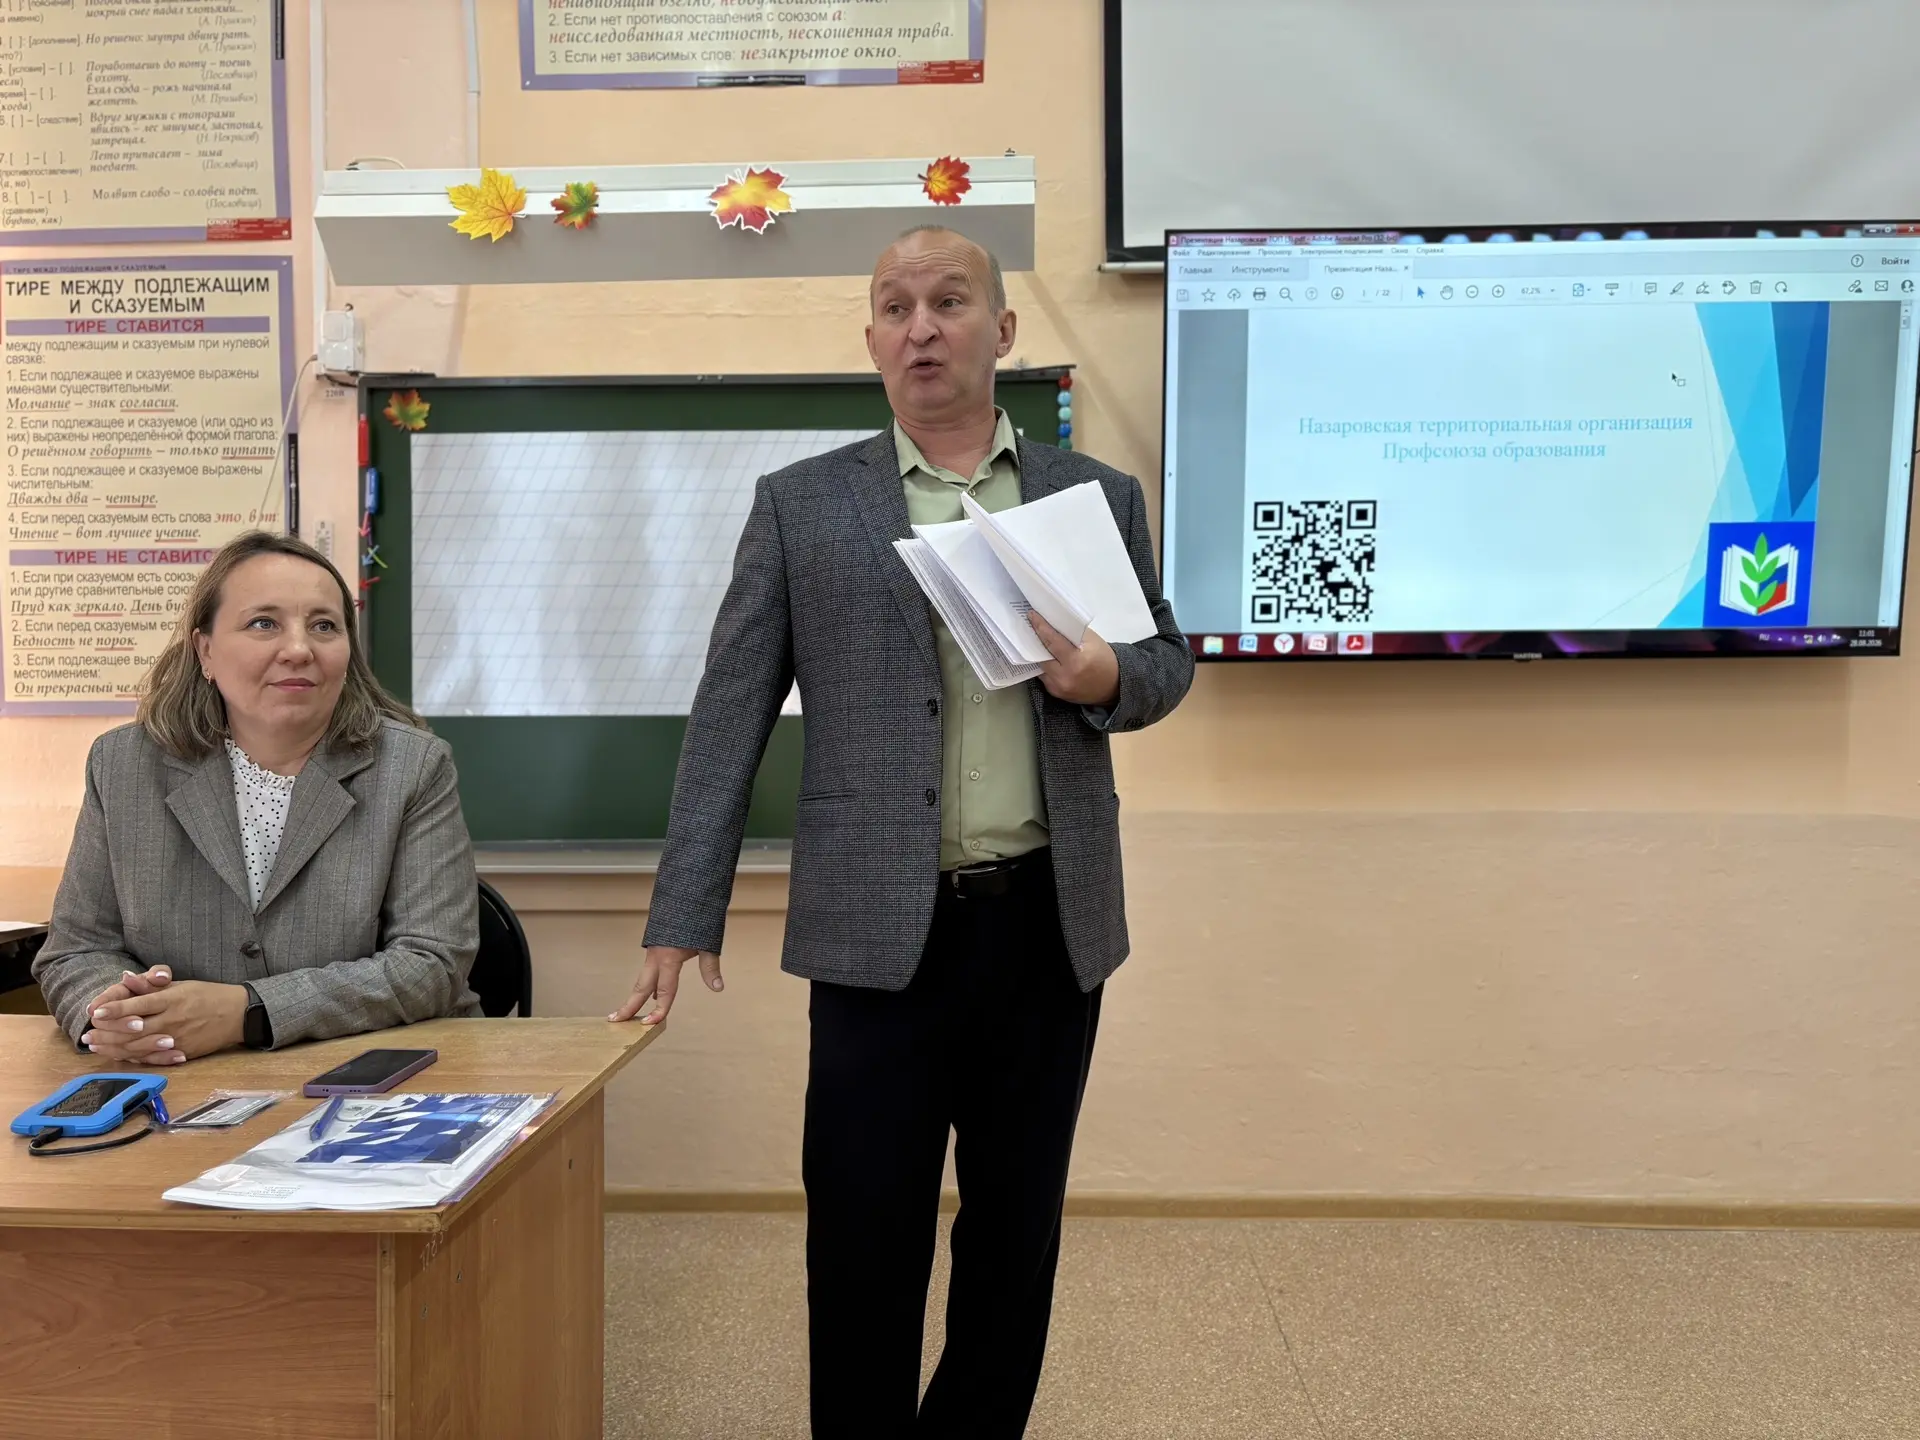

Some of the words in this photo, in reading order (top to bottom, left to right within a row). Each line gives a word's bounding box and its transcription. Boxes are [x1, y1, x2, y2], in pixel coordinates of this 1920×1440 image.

[549, 15, 560, 26] 2.
[564, 13, 597, 26] Если
[601, 15, 622, 25] нет
[627, 12, 763, 29] противопоставления
[778, 12, 828, 22] союзом
[549, 27, 683, 44] неисследованная
[687, 27, 784, 42] местность,
[788, 25, 893, 40] нескошенная
[898, 22, 954, 43] трава.
[549, 52, 560, 63] 3.
[565, 50, 597, 63] Если
[601, 51, 622, 62] нет
[626, 50, 697, 62] зависимых
[701, 50, 736, 61] слов:
[741, 46, 849, 63] незакрытое
[854, 46, 902, 58] окно.
[1881, 256, 1910, 266] Войти
[1232, 265, 1290, 275] Инструменты
[6, 281, 50, 296] ТИРЕ
[61, 279, 124, 297] МЕЖДУ
[135, 277, 269, 296] ПОДЛЕЖАЩИМ
[70, 299, 80, 313] И
[92, 297, 205, 313] СКАЗУЕМЫМ
[65, 320, 106, 333] ТИРЕ
[117, 318, 204, 333] СТАВИТСЯ
[6, 341, 42, 354] между
[45, 339, 119, 352] подлежащим
[122, 340, 129, 349] и
[132, 339, 195, 352] сказуемым
[199, 339, 219, 351] при
[222, 336, 270, 351] нулевой
[6, 354, 46, 365] связке:
[7, 370, 16, 382] 1.
[20, 369, 47, 382] Если
[50, 369, 122, 382] подлежащее
[126, 369, 132, 379] и
[136, 369, 195, 382] сказуемое
[199, 368, 259, 381] выражены
[6, 384, 57, 395] именами
[60, 382, 173, 396] существительными:
[6, 398, 71, 410] Молчание
[88, 399, 116, 409] знак
[120, 398, 179, 409] согласия.
[7, 416, 16, 429] 2.
[20, 416, 48, 429] Если
[52, 417, 124, 430] подлежащее
[128, 418, 134, 427] и
[138, 416, 197, 430] сказуемое
[201, 415, 226, 429] (или
[229, 417, 257, 428] одно
[261, 416, 273, 427] из
[1299, 417, 1412, 438] Назаровская
[1417, 418, 1572, 437] территориальная
[1578, 416, 1692, 435] организация
[7, 431, 30, 444] них)
[33, 430, 89, 444] выражены
[186, 428, 230, 444] формой
[7, 444, 18, 457] О
[22, 445, 86, 460] решённом
[90, 443, 152, 459] говорить
[169, 445, 219, 456] только
[222, 444, 276, 459] путать
[1383, 442, 1486, 463] Профсоюза
[1492, 441, 1606, 462] образования
[7, 464, 17, 476] 3.
[21, 464, 49, 476] Если
[52, 465, 125, 478] подлежащее
[129, 466, 136, 475] и
[139, 464, 198, 478] сказуемое
[202, 464, 263, 477] выражены
[7, 479, 94, 490] числительным:
[7, 491, 62, 507] Дважды
[65, 490, 88, 505] два
[106, 493, 158, 507] четыре.
[8, 512, 18, 524] 4.
[21, 512, 49, 524] Если
[51, 513, 85, 526] перед
[88, 512, 148, 527] сказуемым
[151, 513, 176, 523] есть
[179, 512, 212, 523] слова
[9, 527, 59, 539] Чтение
[76, 526, 102, 539] вот
[105, 528, 152, 541] лучшее
[155, 528, 201, 541] учение.
[55, 551, 97, 564] ТИРЕ
[107, 550, 128, 563] НЕ
[138, 549, 213, 563] СТАВИТС
[11, 572, 19, 583] 1.
[23, 571, 51, 583] Если
[54, 572, 74, 587] при
[77, 572, 134, 587] сказуемом
[137, 572, 161, 582] есть
[10, 586, 33, 596] или
[35, 585, 73, 599] другие
[77, 585, 163, 599] сравнительные
[11, 600, 45, 614] Пруд
[48, 602, 71, 612] как
[74, 602, 127, 614] зеркало.
[130, 601, 163, 614] День
[12, 620, 22, 632] 2.
[26, 620, 53, 632] Если
[57, 621, 91, 635] перед
[94, 620, 157, 635] сказуемым
[13, 635, 75, 648] Бедность
[79, 637, 93, 647] не
[95, 636, 138, 649] порок.
[13, 655, 23, 666] 3.
[27, 654, 55, 666] Если
[58, 654, 130, 668] подлежащее
[14, 669, 101, 680] местоимением:
[14, 682, 34, 694] Он
[37, 681, 113, 698] прекрасный
